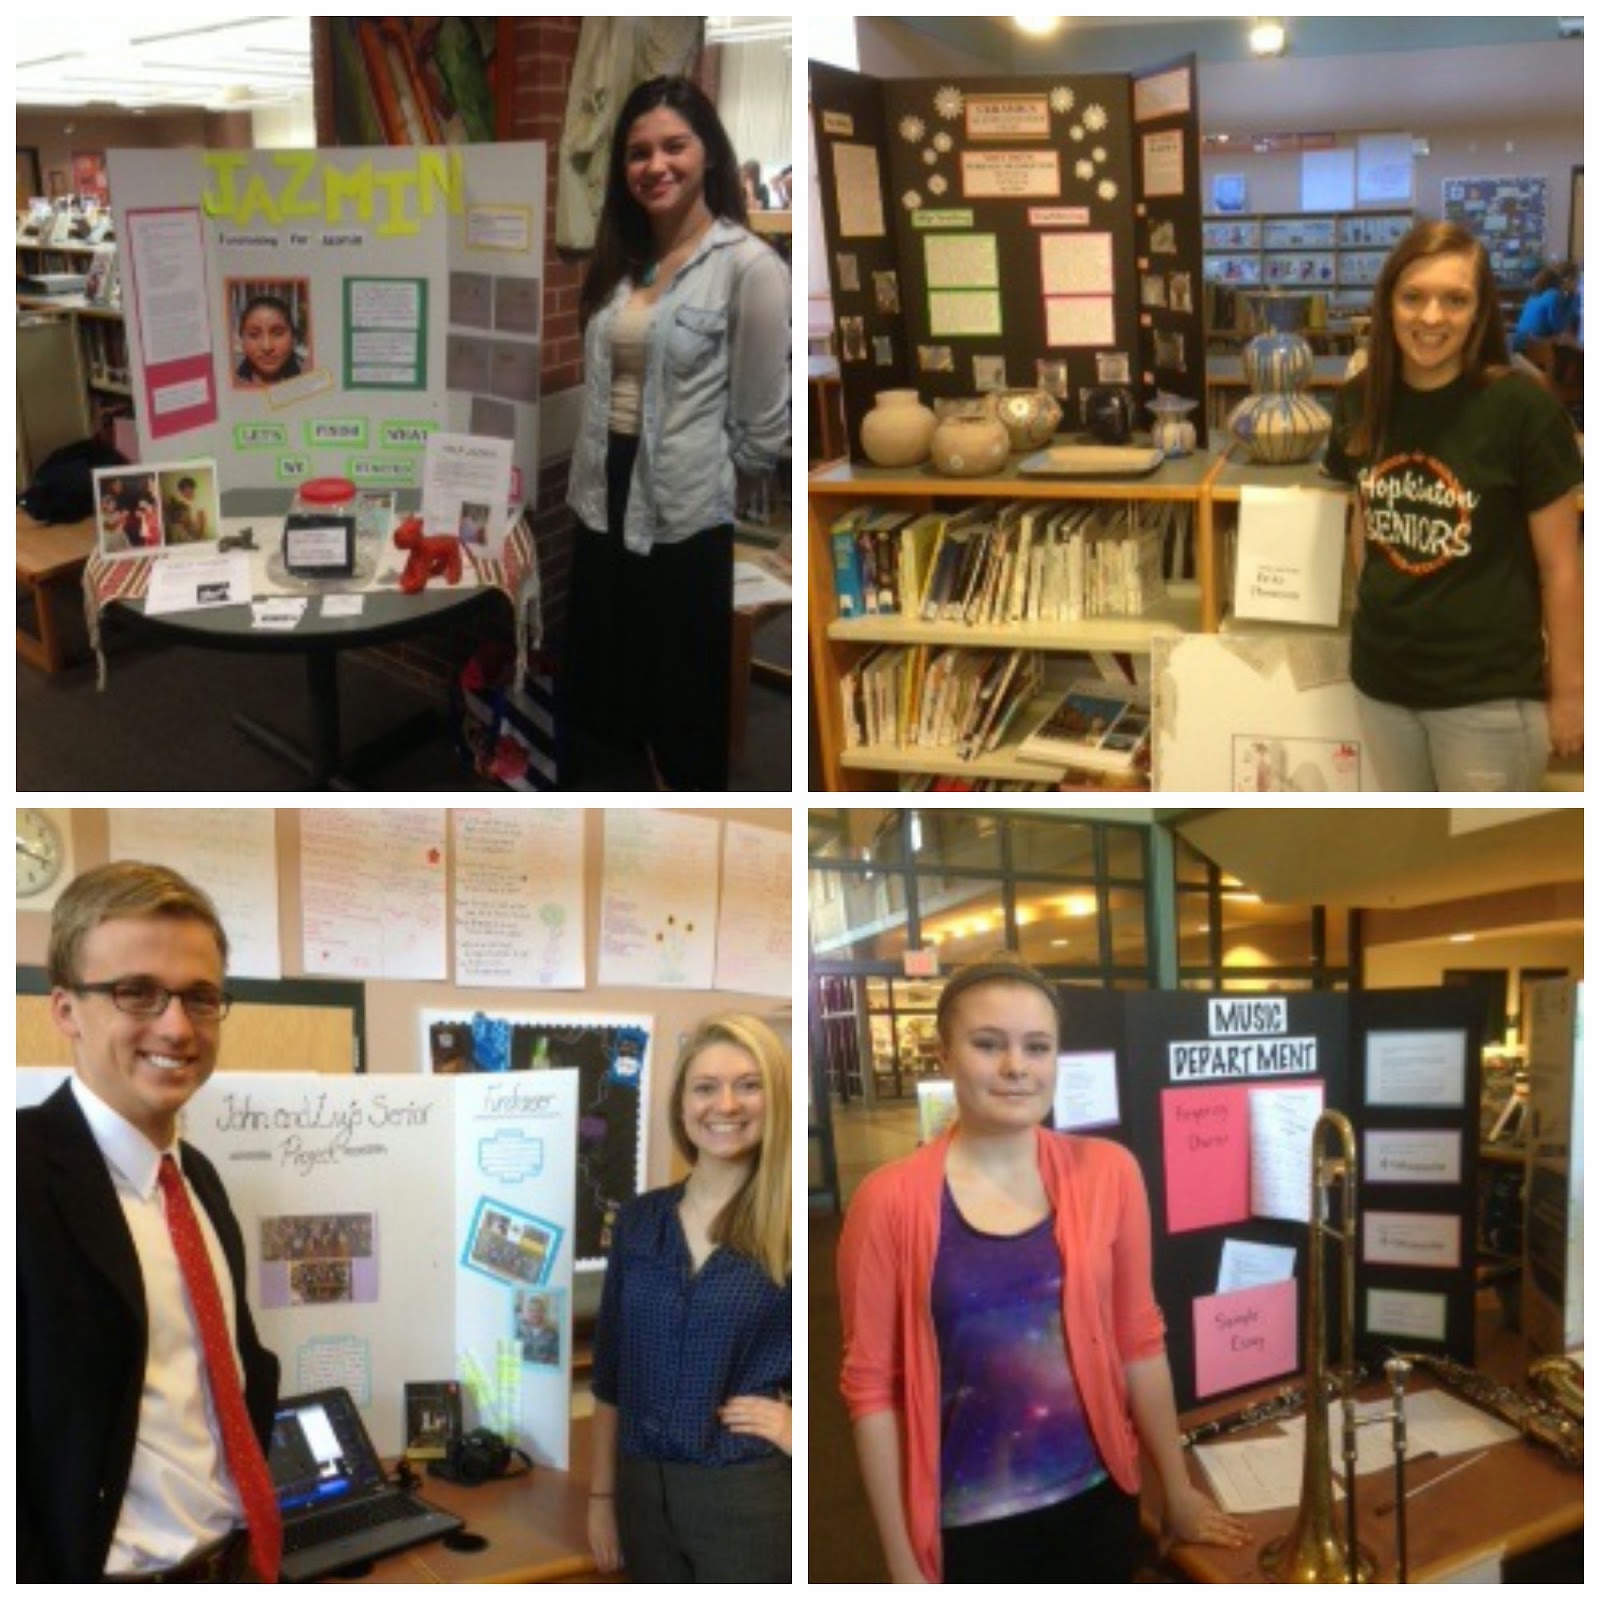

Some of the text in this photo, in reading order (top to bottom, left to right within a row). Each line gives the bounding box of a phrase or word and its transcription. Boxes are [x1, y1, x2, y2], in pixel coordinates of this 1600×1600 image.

[202, 151, 464, 236] JAZMIN
[1358, 467, 1480, 510] Hopkinton
[1365, 508, 1472, 557] SENIORS
[1215, 1003, 1281, 1032] MUSIC
[216, 1092, 269, 1131] John
[274, 1094, 311, 1129] and
[367, 1094, 434, 1127] Senior
[277, 1134, 341, 1177] Project
[1214, 1306, 1259, 1332] Sample
